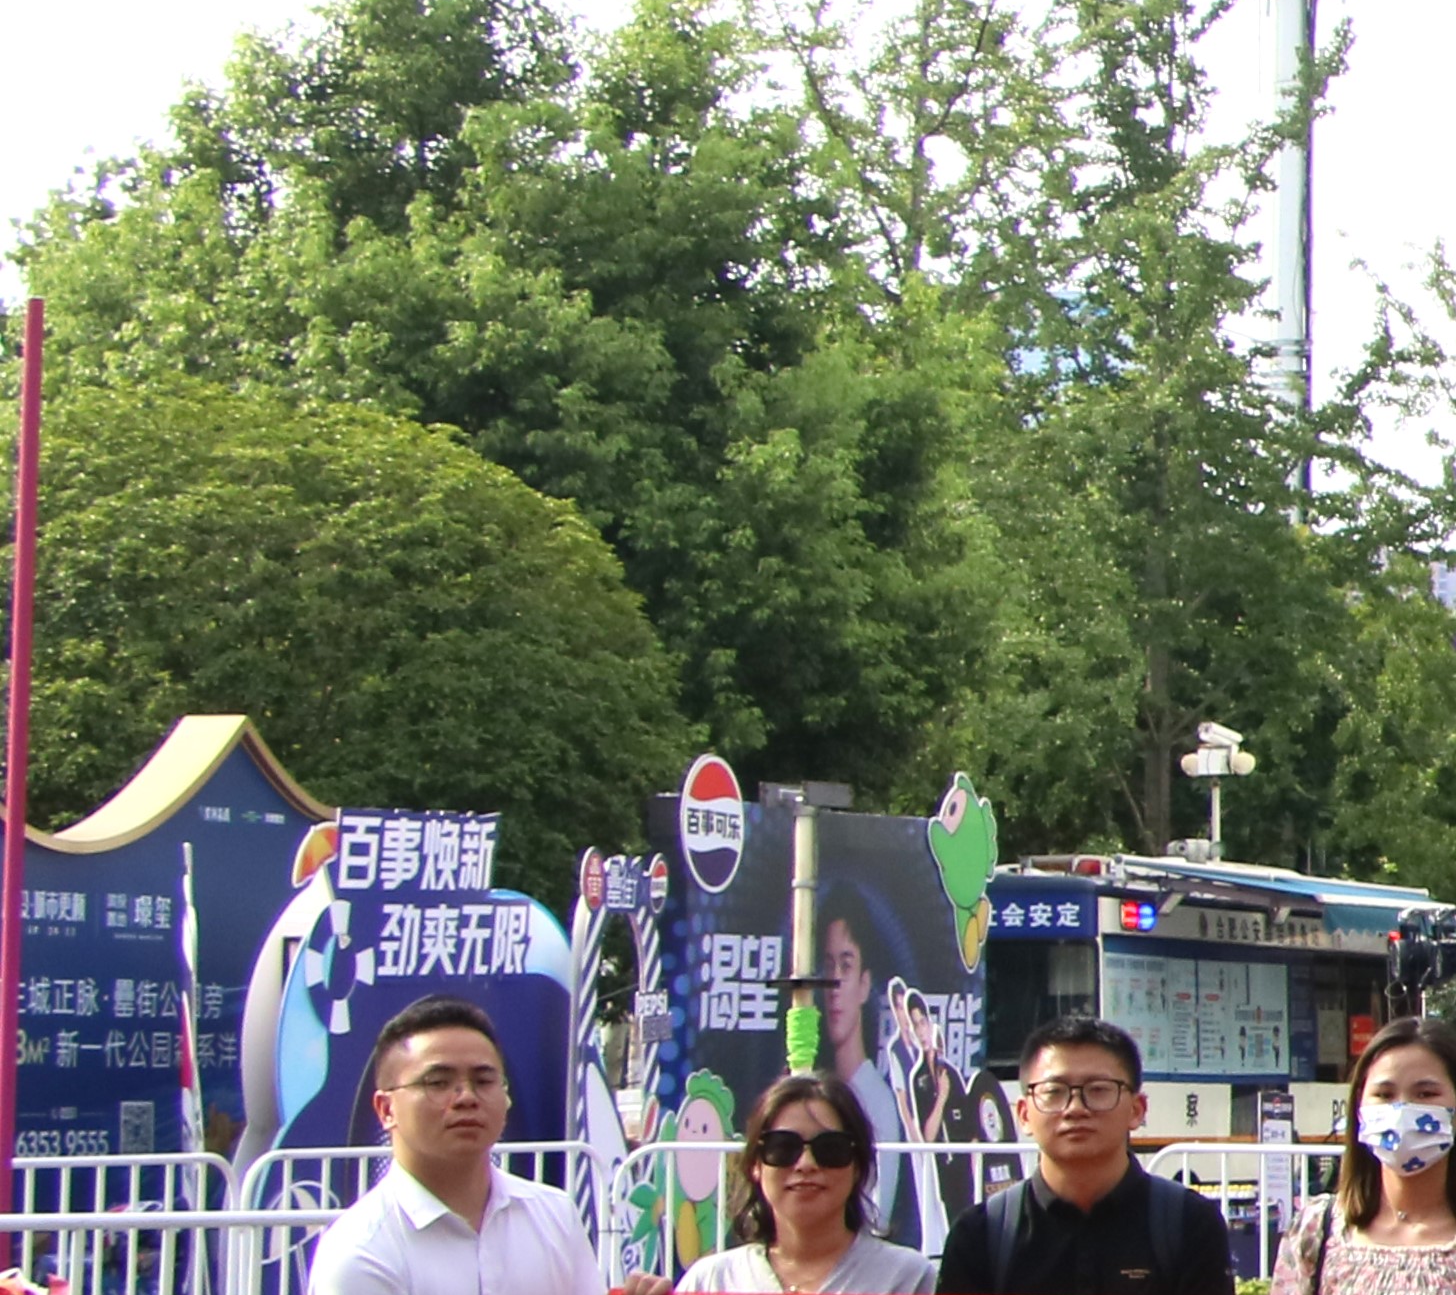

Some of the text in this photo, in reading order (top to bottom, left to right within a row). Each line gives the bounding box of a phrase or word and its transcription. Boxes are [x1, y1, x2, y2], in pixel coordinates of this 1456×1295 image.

[338, 816, 496, 890] 百事焕新
[687, 807, 741, 841] 百事可乐
[377, 903, 528, 976] 劲爽无限
[700, 932, 783, 1032] 渴望
